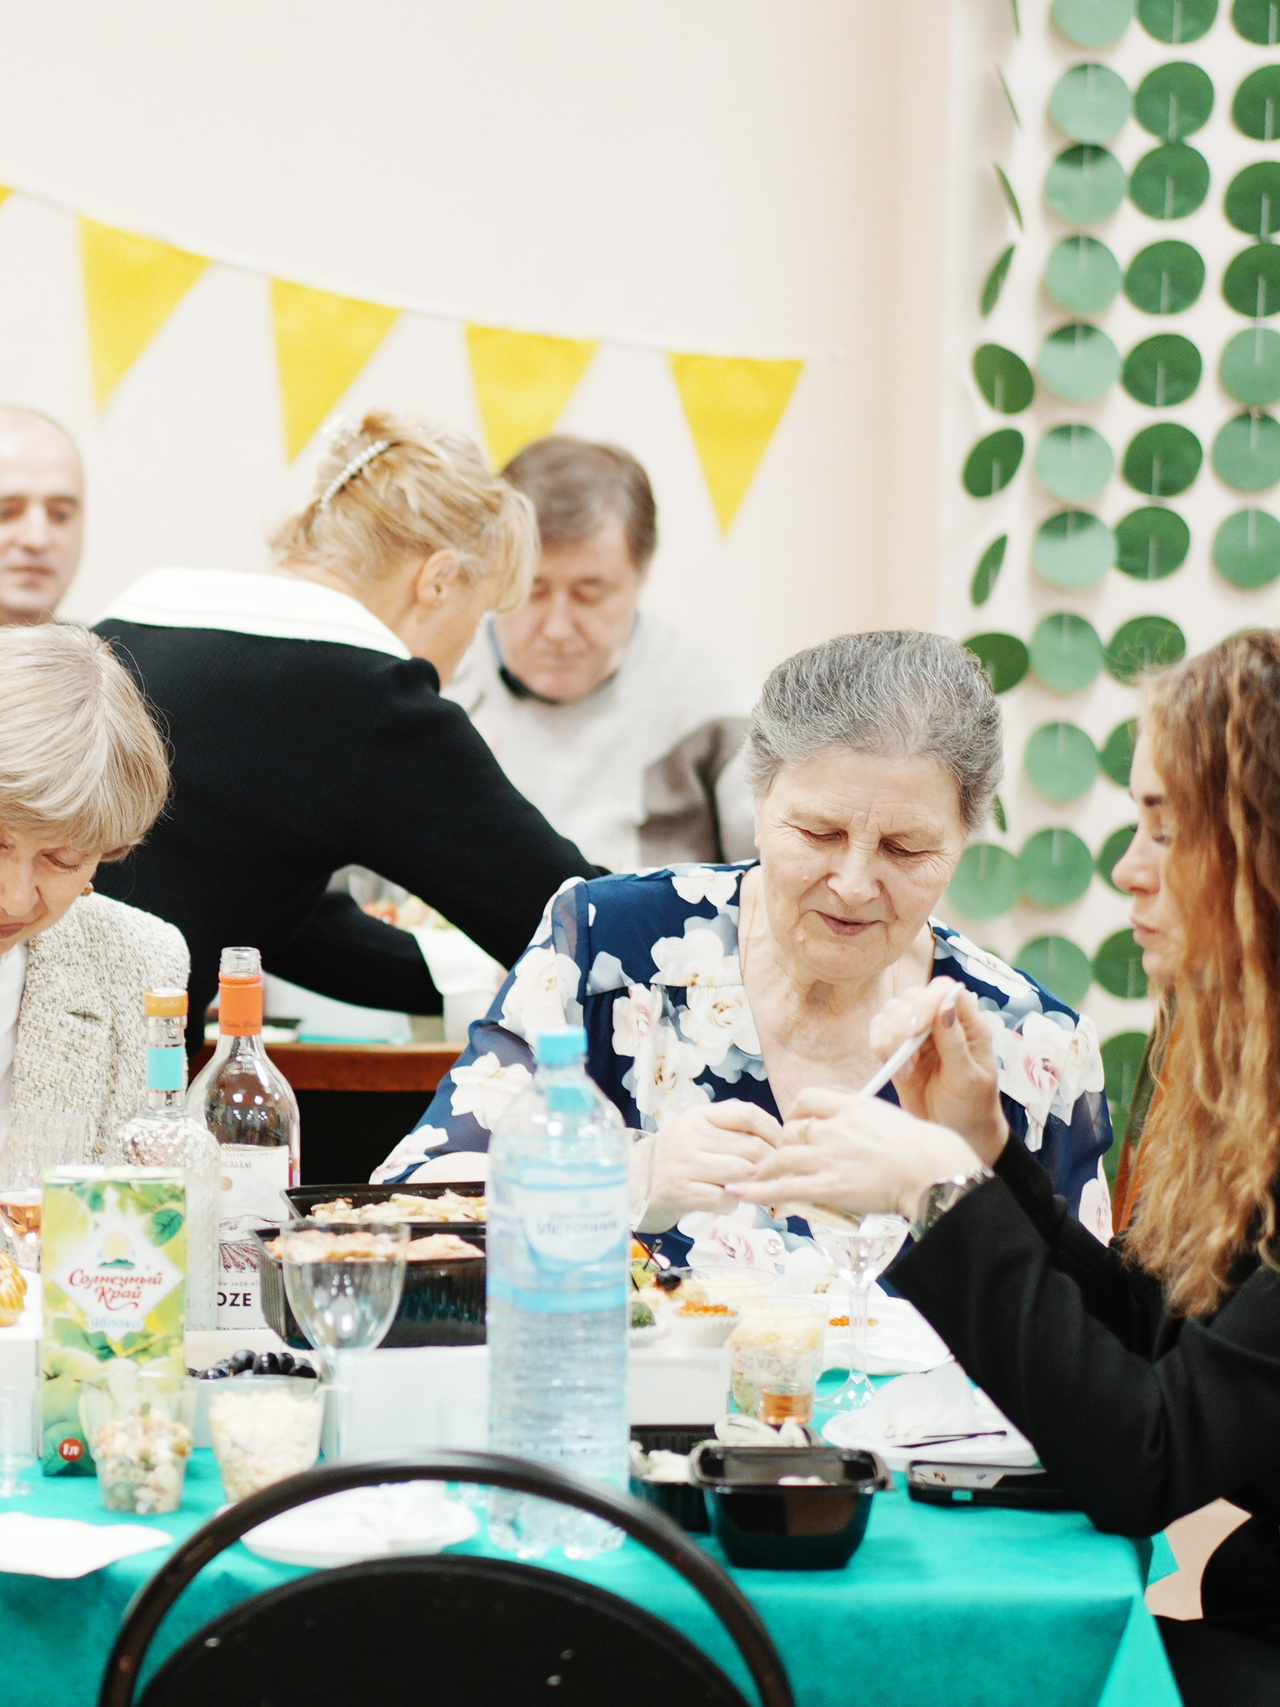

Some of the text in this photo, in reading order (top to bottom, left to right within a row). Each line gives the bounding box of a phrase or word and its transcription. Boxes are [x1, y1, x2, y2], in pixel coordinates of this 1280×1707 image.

[69, 1268, 162, 1290] Солнечный
[95, 1286, 141, 1311] Край
[217, 1291, 252, 1307] OZE
